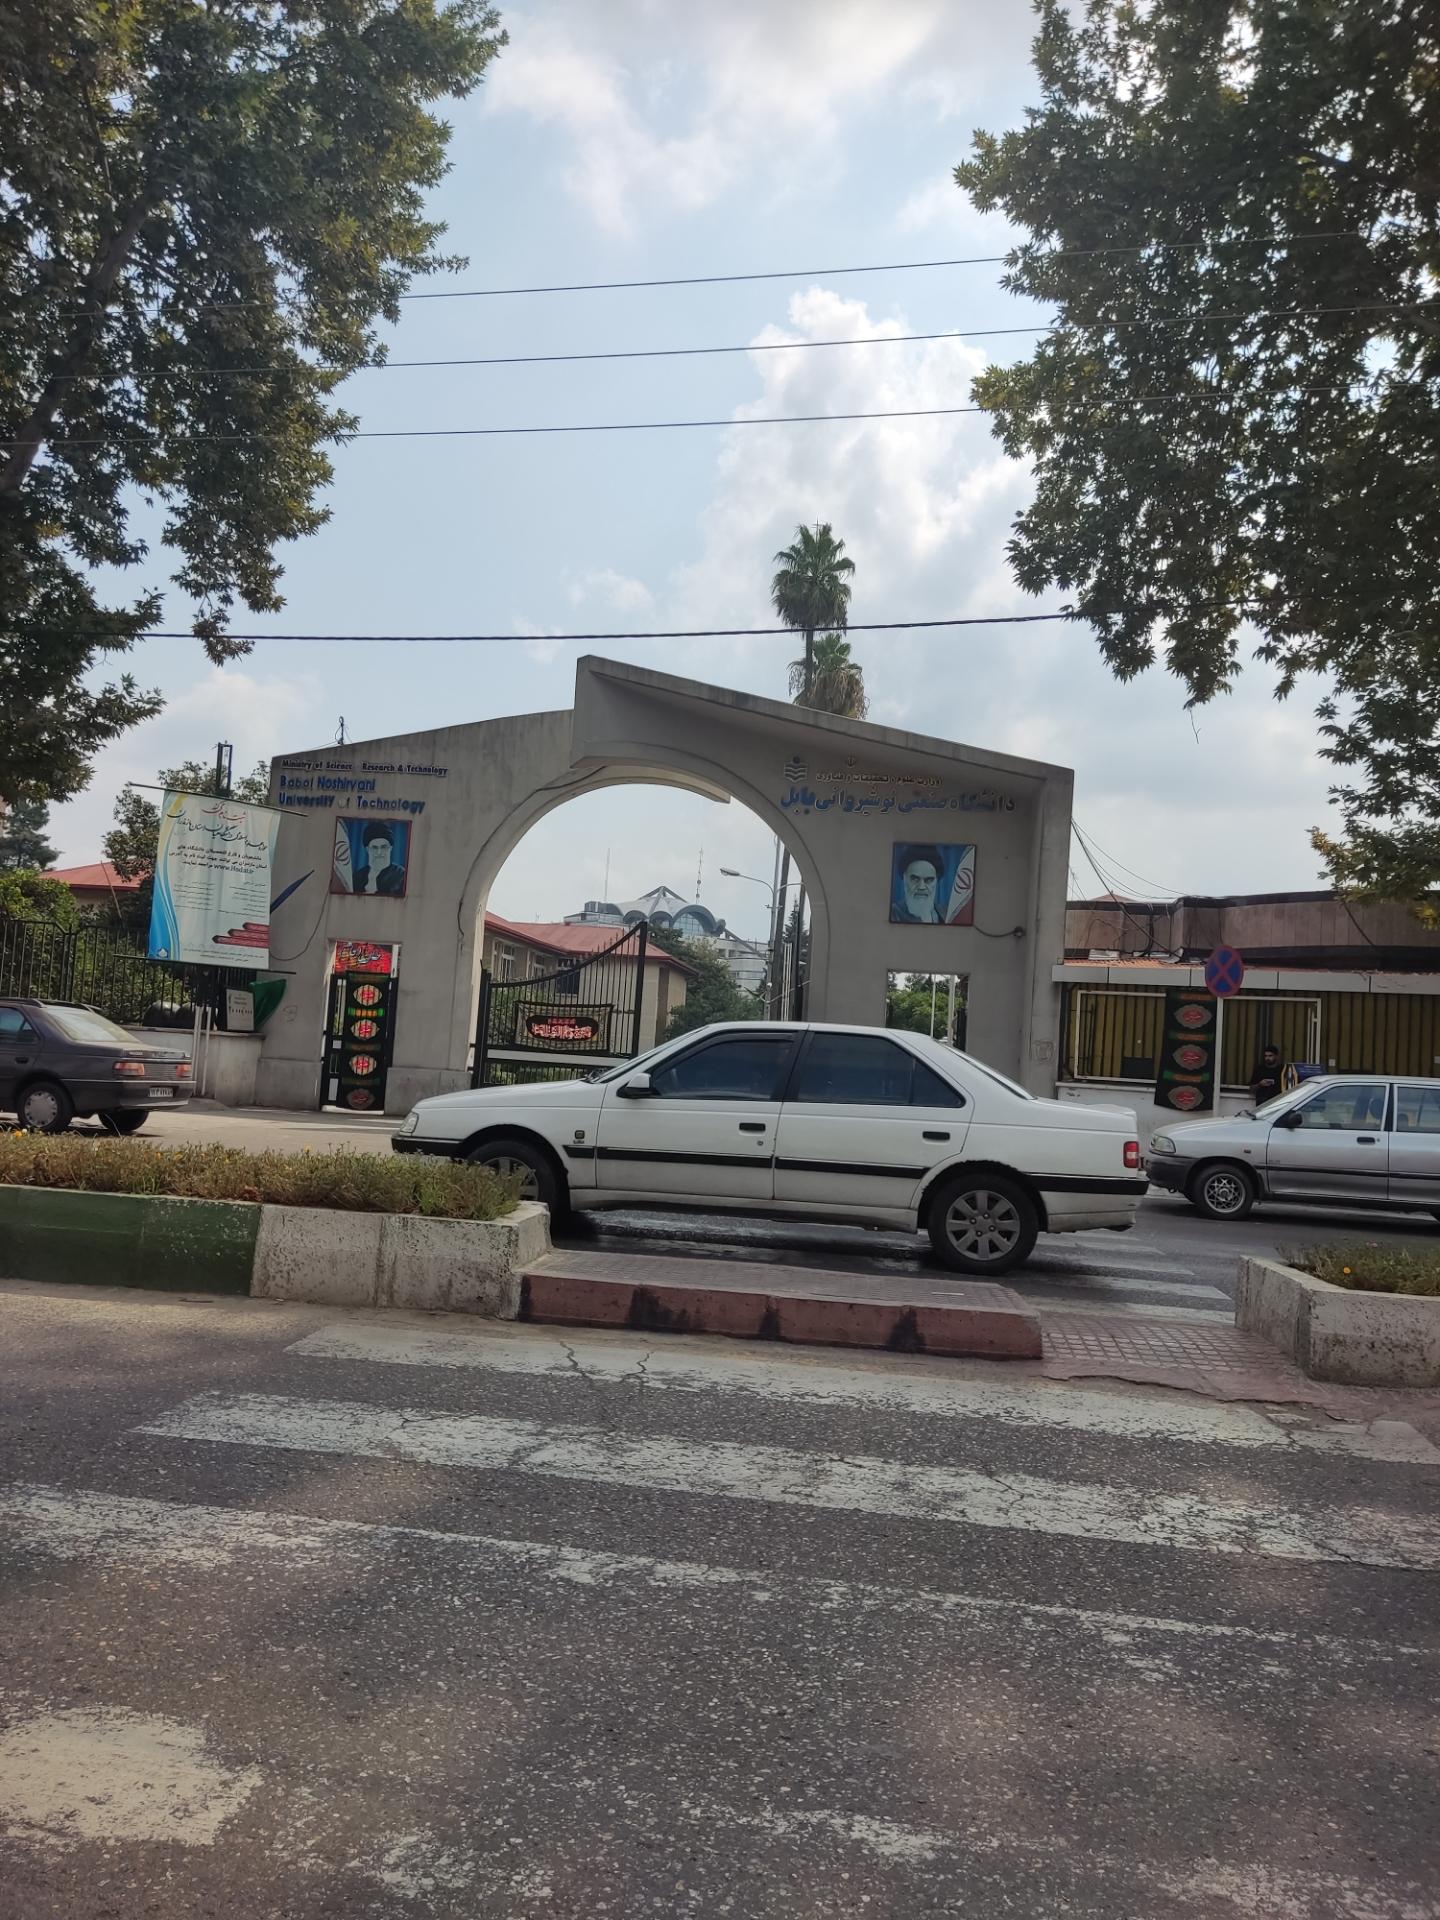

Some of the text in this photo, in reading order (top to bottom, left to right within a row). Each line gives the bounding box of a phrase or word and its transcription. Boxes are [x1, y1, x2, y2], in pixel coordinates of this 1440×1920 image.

[282, 760, 312, 771] Ministry
[326, 761, 352, 770] Science
[362, 763, 448, 777] Research & Technology
[280, 775, 376, 791] Babol Noshirvani
[279, 792, 335, 808] University
[357, 795, 425, 815] Technology
[780, 786, 1016, 816] دانشگاه صنعتی نوشیروانی بابل
